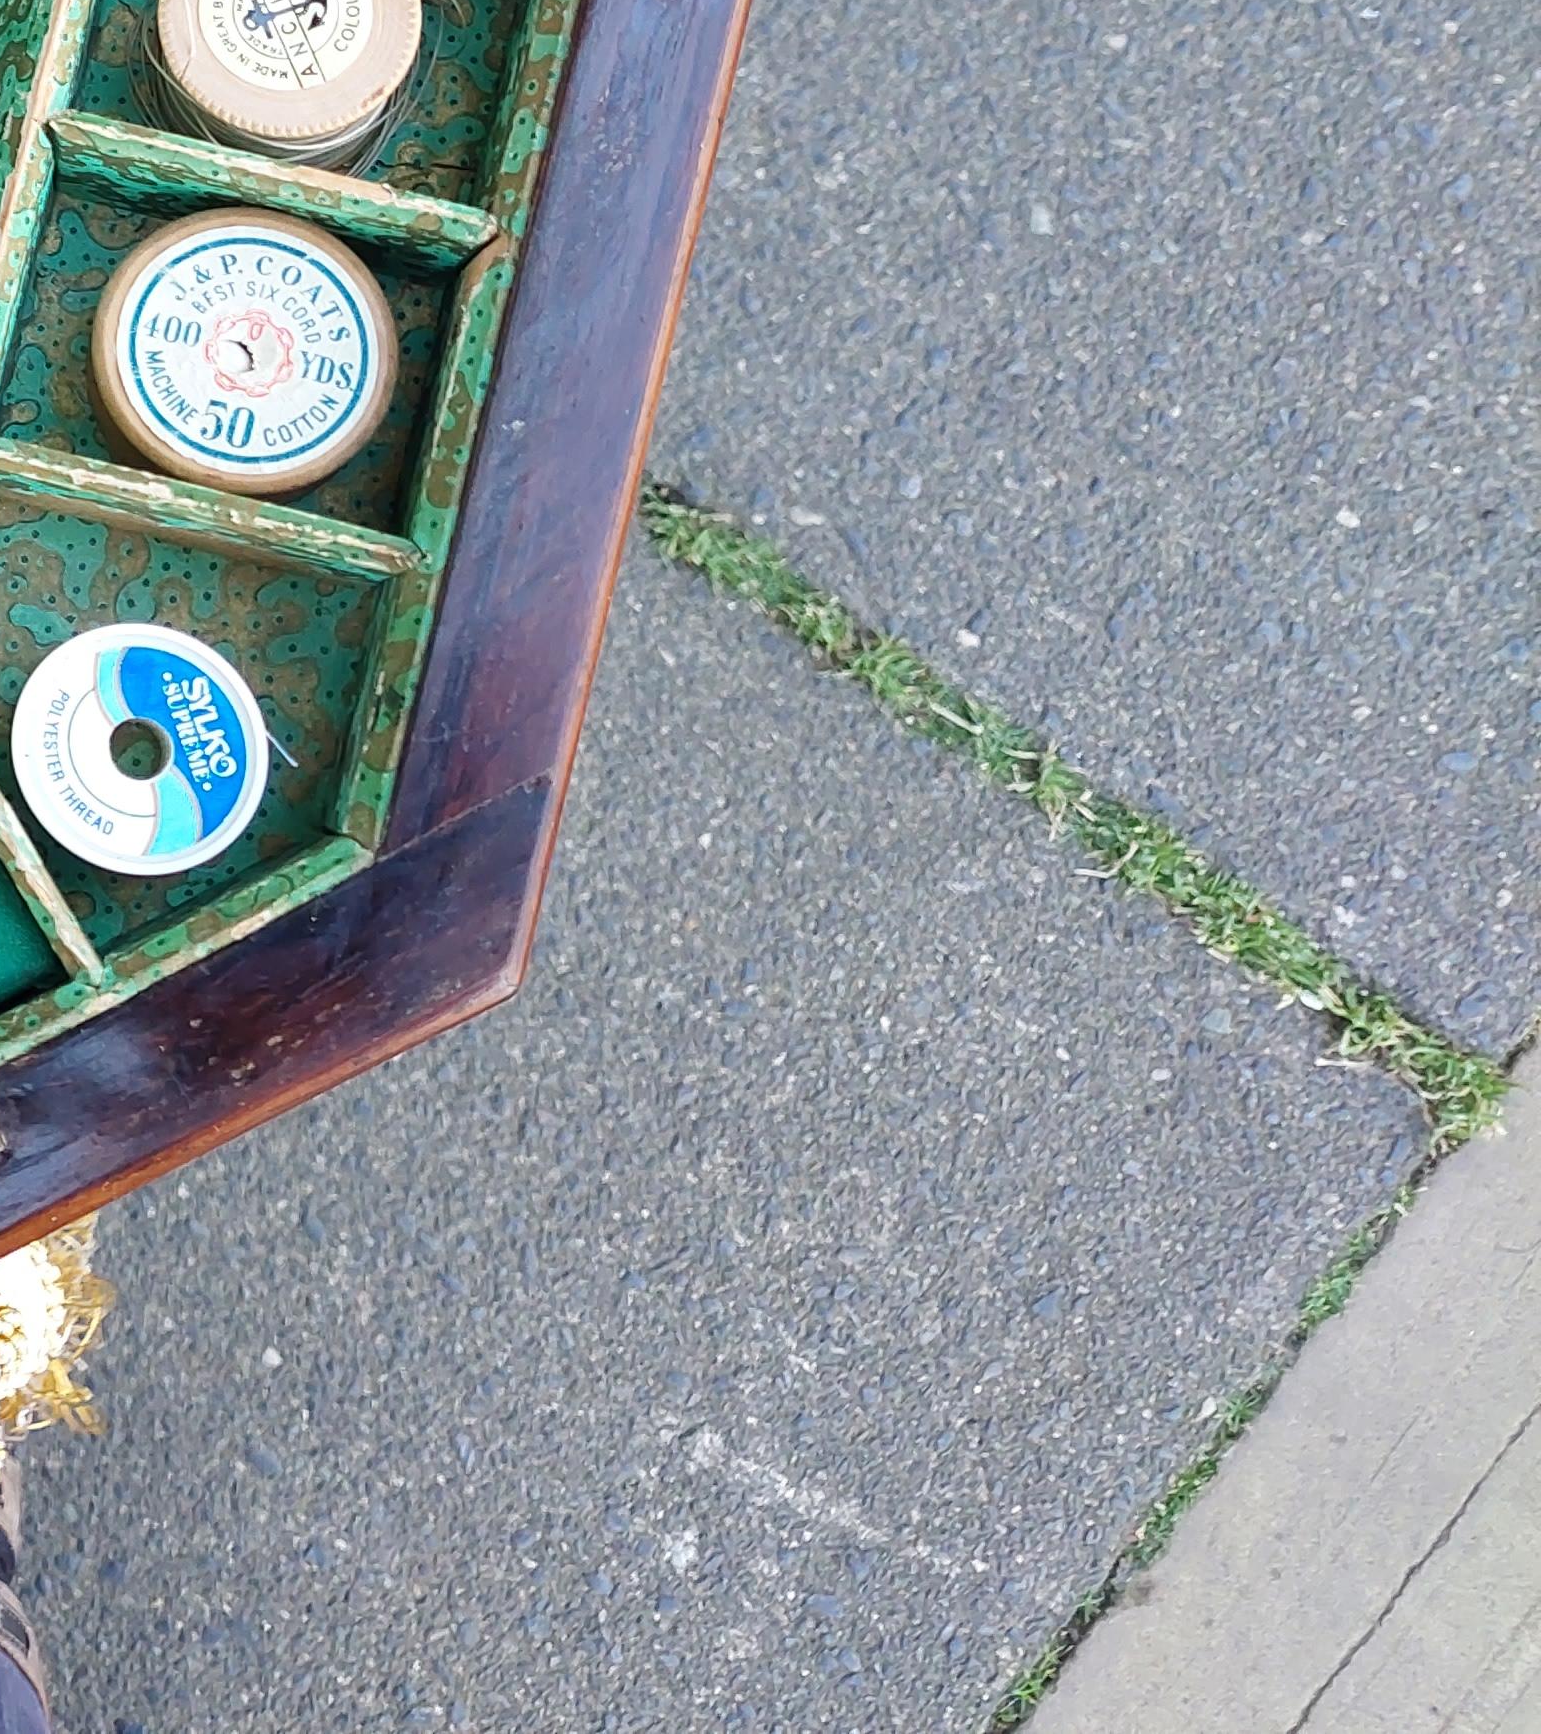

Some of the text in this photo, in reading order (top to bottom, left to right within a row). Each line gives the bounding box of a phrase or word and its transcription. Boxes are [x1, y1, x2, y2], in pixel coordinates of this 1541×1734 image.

[213, 15, 238, 53] GREAT
[237, 53, 251, 67] IN
[248, 35, 283, 56] TRADE
[252, 62, 289, 79] MADE
[191, 281, 322, 344] BEST SIX CORD
[192, 264, 213, 284] &
[219, 253, 244, 275] P.
[256, 256, 351, 343] COATS
[143, 312, 202, 348] 400
[146, 350, 340, 448] MACHINE 50 COTTON
[161, 679, 210, 785] SUPREME
[181, 675, 237, 778] SYLKO
[43, 688, 115, 836] POLYESTER THREAD
